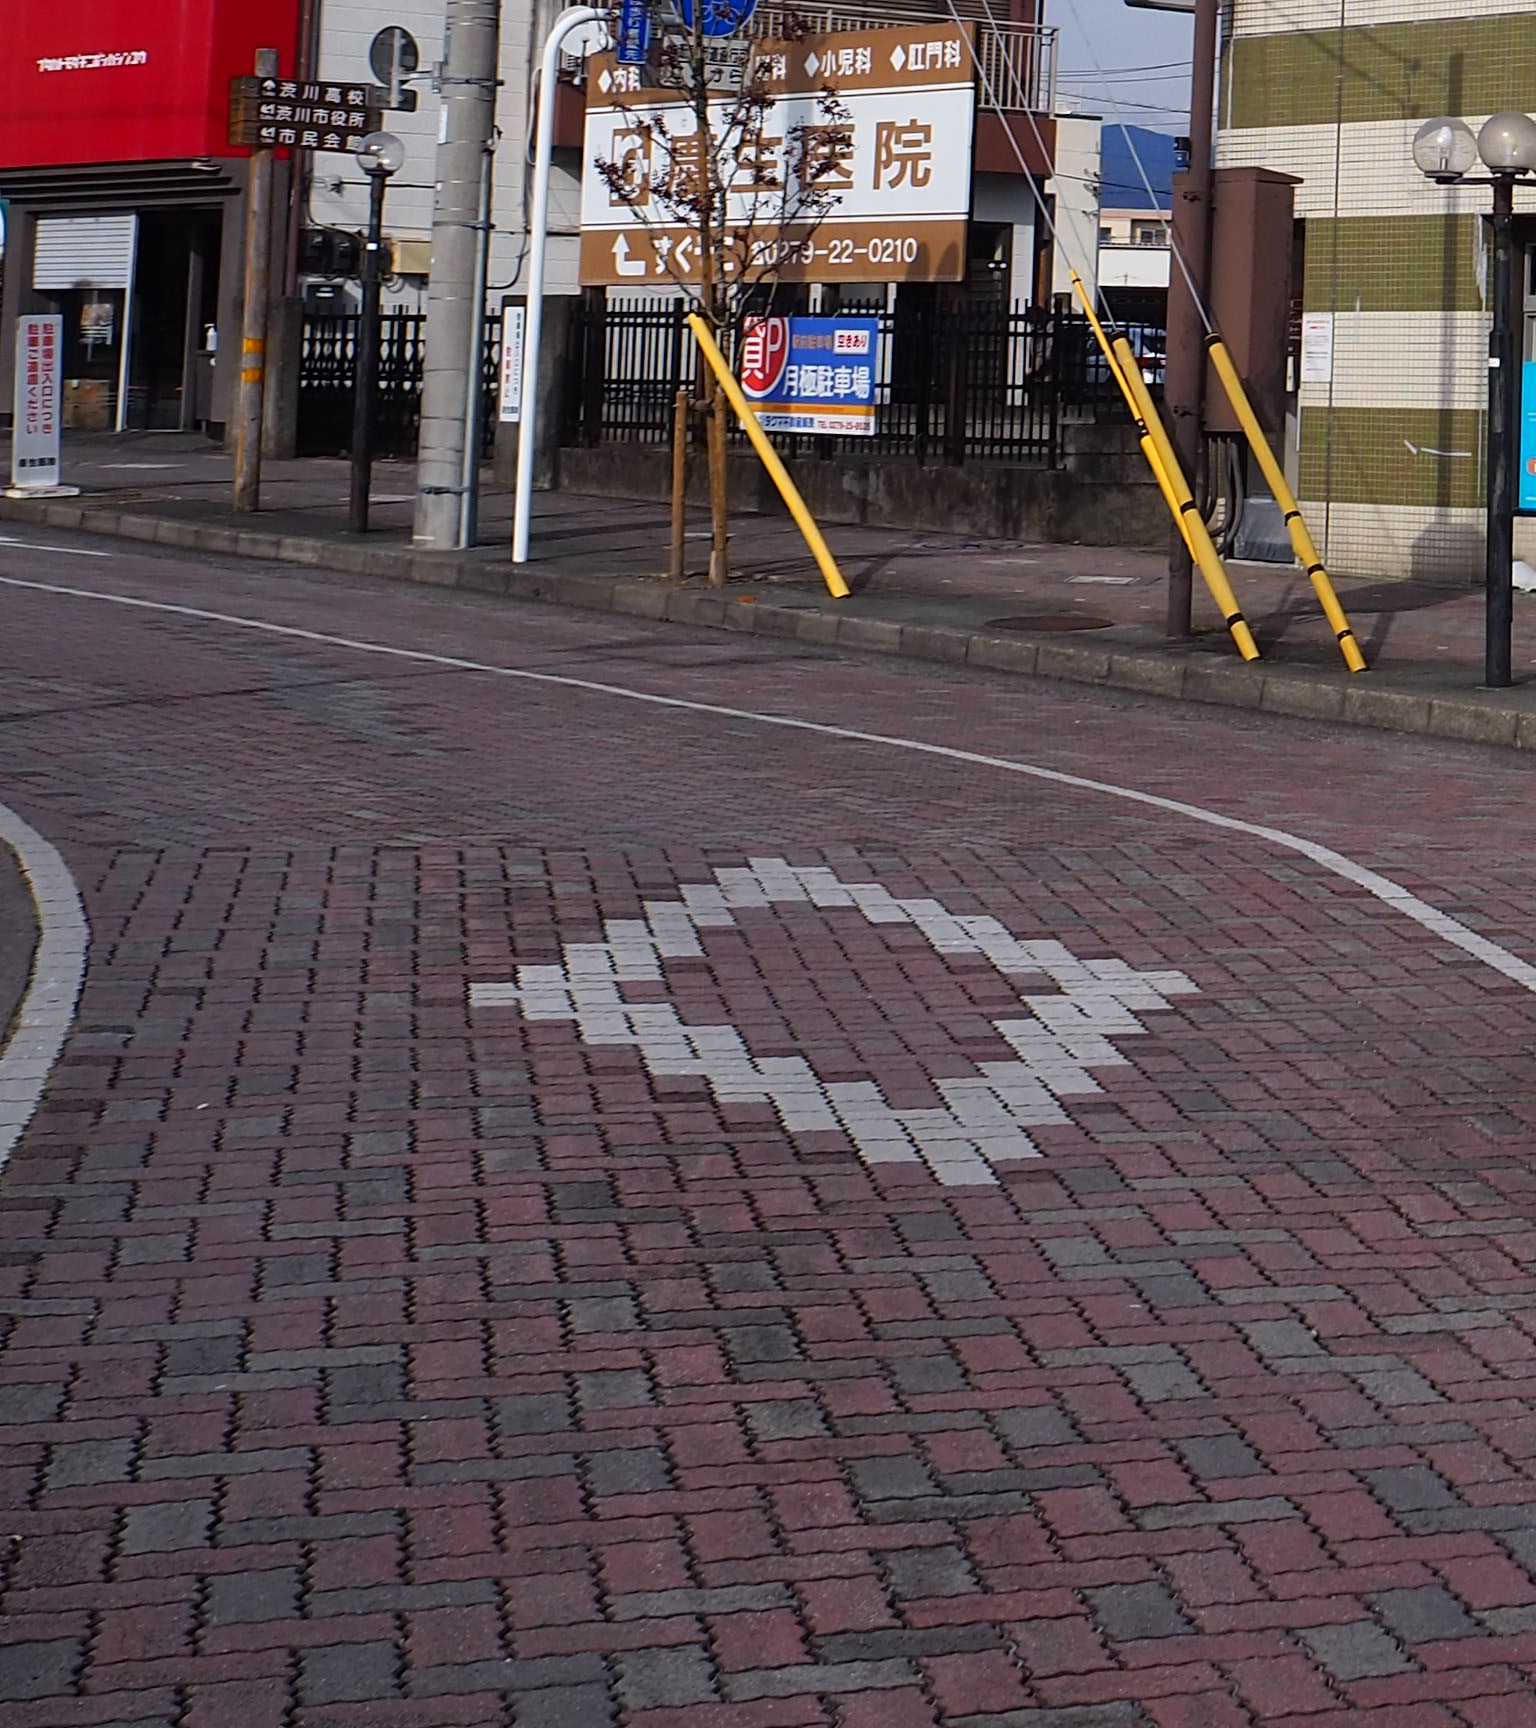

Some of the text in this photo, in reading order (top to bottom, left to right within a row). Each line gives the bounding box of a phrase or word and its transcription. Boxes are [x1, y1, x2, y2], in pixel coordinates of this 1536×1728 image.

[821, 47, 873, 77] 小児科
[908, 40, 962, 71] 肛門科
[278, 81, 366, 106] 渋川高校
[275, 104, 367, 129] 渋川市役所
[782, 364, 872, 400] 月極駐車場
